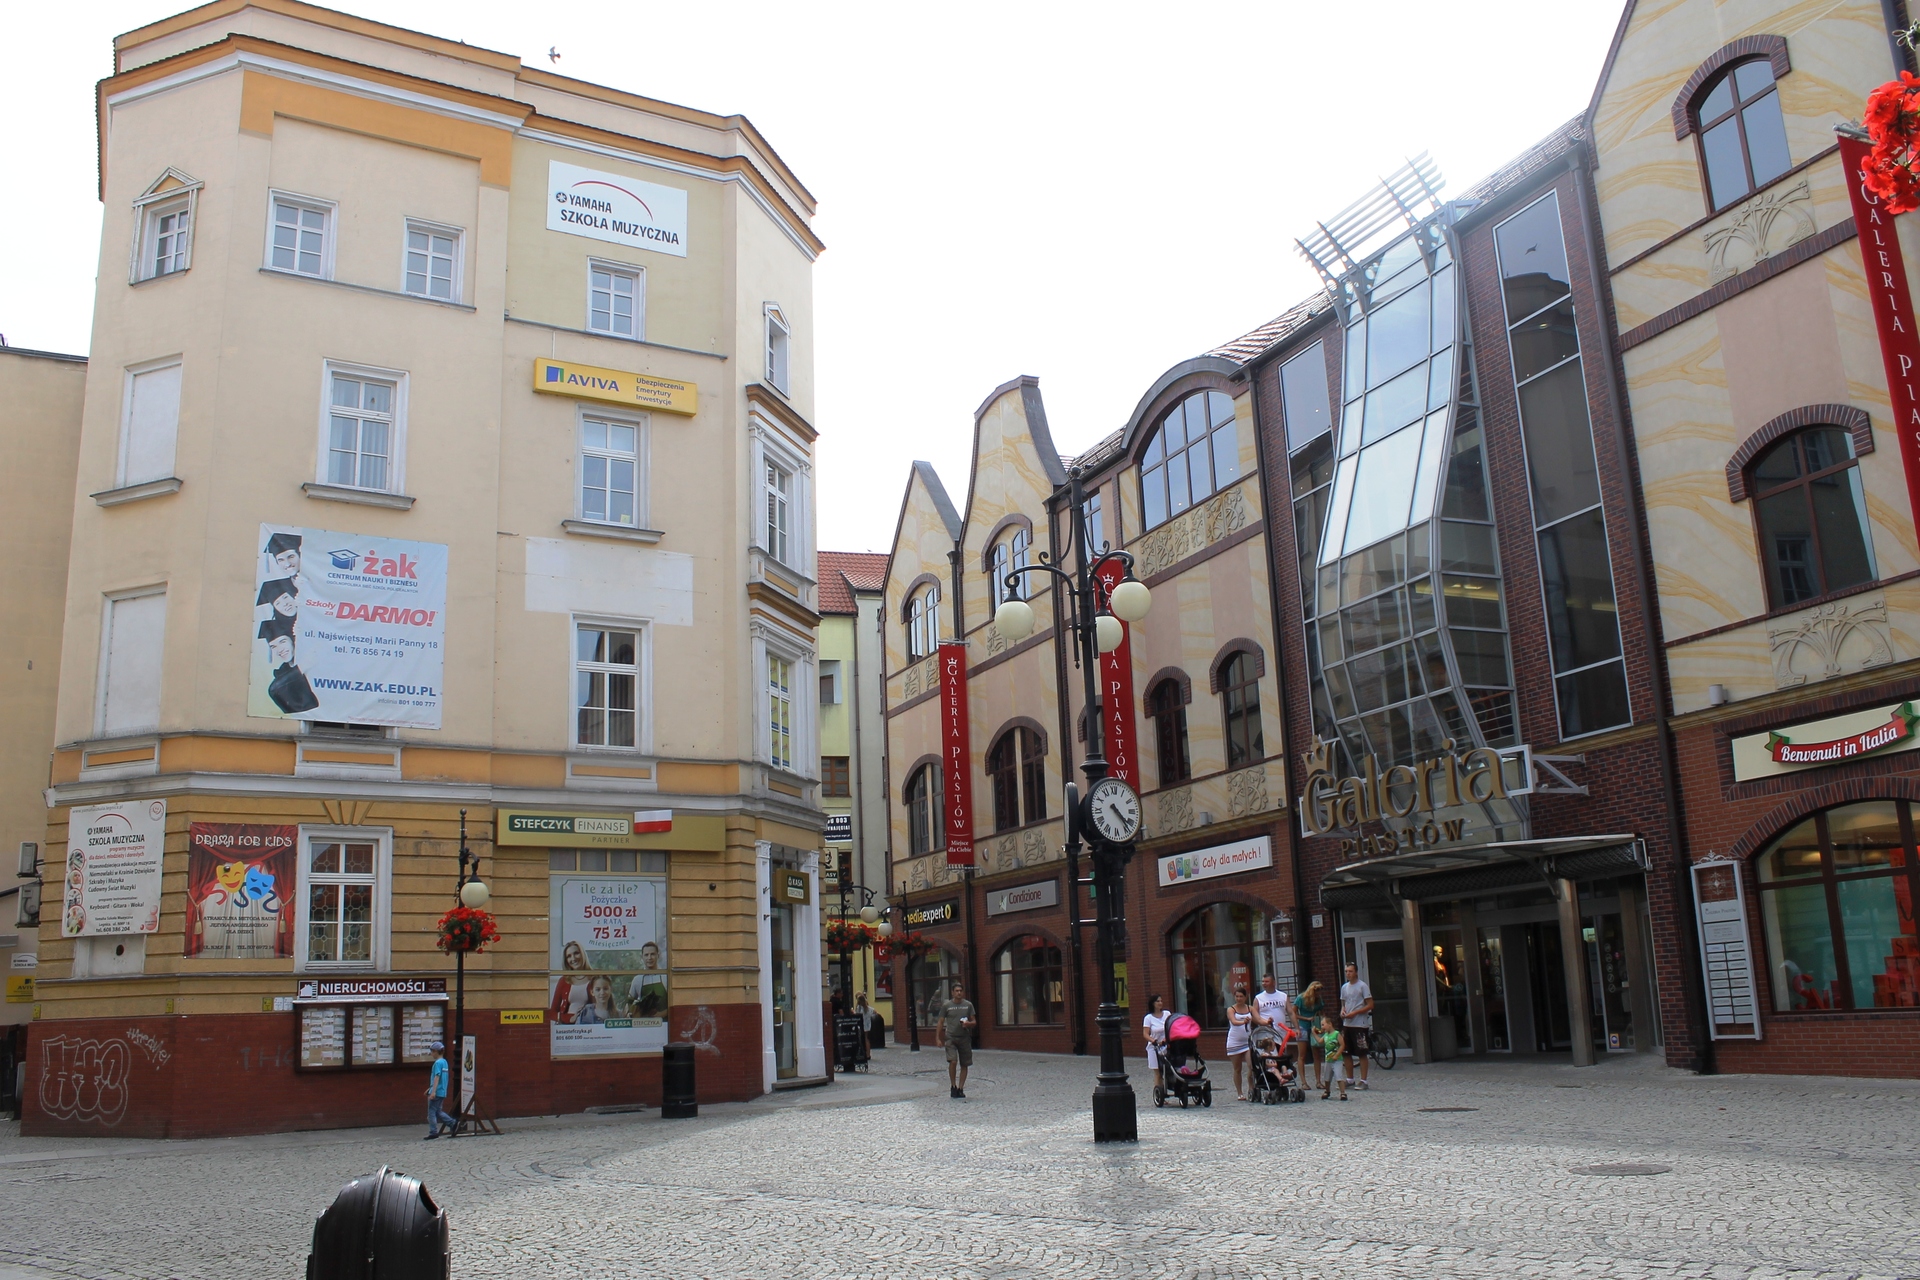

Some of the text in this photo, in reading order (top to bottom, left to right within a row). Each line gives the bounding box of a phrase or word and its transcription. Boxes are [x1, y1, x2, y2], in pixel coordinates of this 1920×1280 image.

[569, 194, 612, 214] YAMAHA
[561, 209, 679, 244] SZKOŁA MUZYCZNA
[568, 374, 619, 392] AVIVA
[636, 378, 684, 391] Ubezpieczenia
[636, 386, 671, 398] Emerytury
[636, 394, 672, 406] Inwestycje
[363, 550, 418, 579] żak
[328, 572, 361, 582] CENTRUM
[362, 576, 383, 584] NAUKI
[390, 578, 418, 588] BIZNESU
[306, 600, 336, 610] Szkoły
[336, 602, 436, 626] DARMO!
[318, 631, 372, 646] Najświętszej
[375, 637, 396, 646] Marii
[400, 638, 425, 649] Panny
[334, 646, 348, 654] tel.
[363, 648, 378, 656] 856
[394, 650, 404, 658] 19
[314, 678, 436, 696] WWW.ZAK.EDU.PL
[947, 665, 964, 828] GALERIA PIASTÓW
[1781, 728, 1897, 761] Benvenuti in Italia
[1303, 738, 1508, 834] Galeria
[93, 826, 112, 834] YAMAHA
[514, 818, 624, 831] STEFCZYK FINANSE
[89, 834, 145, 846] SZKOŁA MUZYCZNA
[196, 835, 292, 847] DRAMA FOR KIDS
[1341, 818, 1464, 858] PIASTÓW
[1202, 856, 1217, 869] Cały
[1220, 853, 1230, 865] dla
[1232, 848, 1257, 864] małych
[120, 884, 136, 892] Muzyki
[581, 884, 638, 894] ile za ile?
[592, 896, 628, 904] Pożyczka
[1009, 890, 1041, 904] Condizione
[584, 905, 636, 918] 5000 zł
[594, 925, 627, 939] 75 zł
[589, 939, 630, 948] miesięcznie
[320, 980, 426, 994] NIERUCHOMOŚCI
